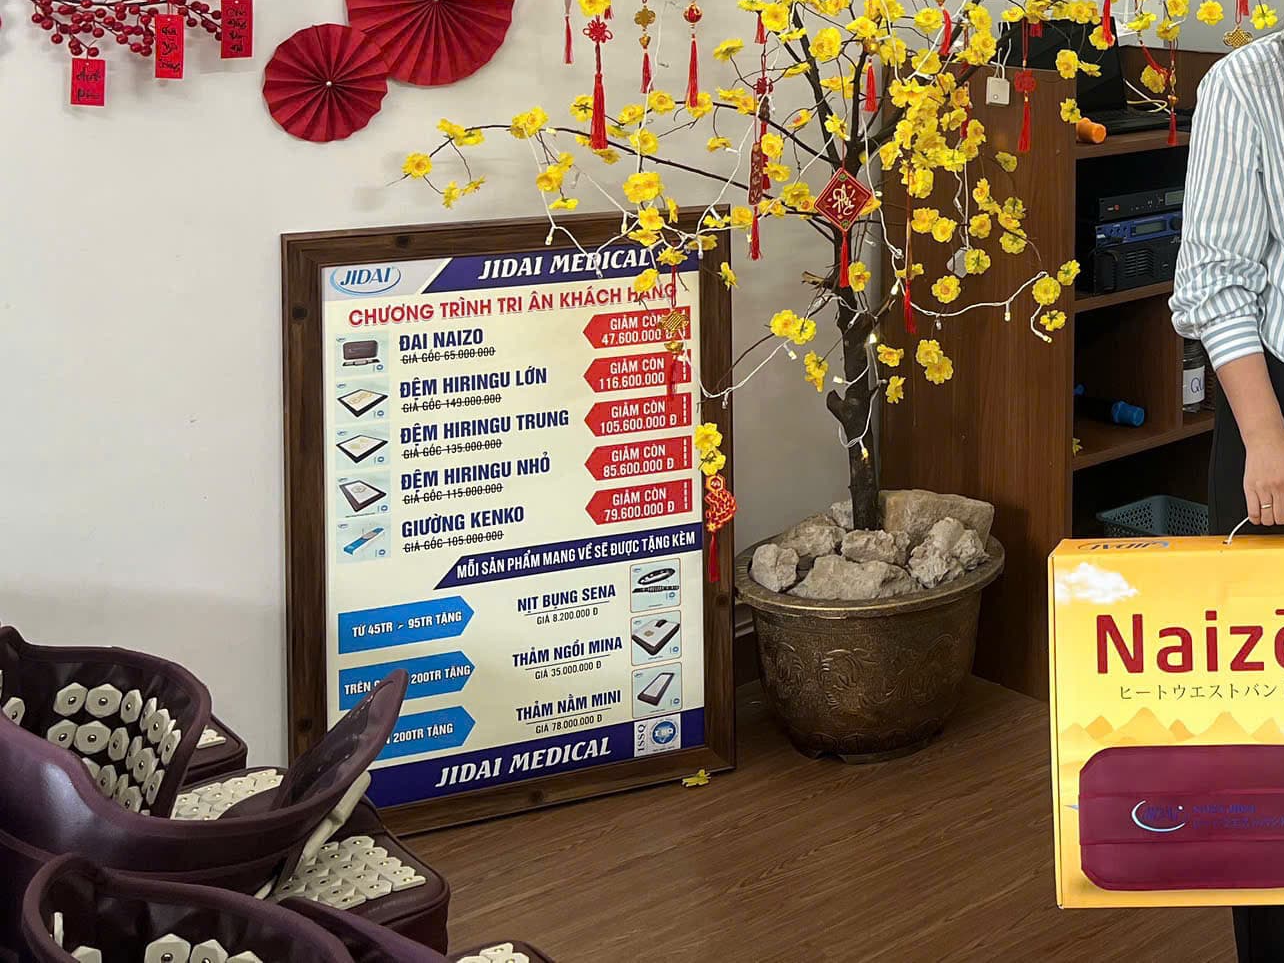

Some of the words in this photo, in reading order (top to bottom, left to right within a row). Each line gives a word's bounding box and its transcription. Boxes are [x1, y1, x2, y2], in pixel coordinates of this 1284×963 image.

[340, 267, 391, 286] JIDAI
[478, 255, 543, 280] JIDAI
[549, 248, 651, 273] MEDICAL
[348, 303, 434, 326] CHƯƠNG
[439, 297, 492, 318] TRÌNH
[497, 296, 522, 313] TRI
[528, 291, 553, 309] ÂN
[560, 286, 621, 307] KHÁCH
[399, 333, 427, 351] ĐAI
[433, 328, 483, 348] NAIZO
[601, 329, 662, 346] 47.600.000
[610, 358, 638, 374] GIẢM
[642, 357, 664, 371] CÒN
[399, 377, 437, 400] ĐỆM
[443, 371, 510, 394] HIRINGU
[515, 366, 547, 386] LỚN
[600, 372, 665, 390] 116.600.000
[611, 402, 639, 418] GIẢM
[643, 400, 665, 414] CÒN
[400, 423, 438, 446] ĐỆM
[443, 416, 511, 439] HIRINGU
[516, 410, 569, 431] TRUNG
[600, 415, 666, 434] 105.600.000
[611, 445, 639, 462] GIẢM
[643, 444, 666, 458] CÒN
[400, 469, 438, 493] ĐỆM
[444, 461, 512, 485] HIRINGU
[516, 451, 550, 476] NHỎ
[603, 458, 663, 477] 85.600.000
[612, 489, 640, 506] GIẢM
[644, 487, 666, 501] CÒN
[401, 513, 465, 538] GIƯỜNG
[470, 506, 525, 529] KENKO
[604, 502, 664, 522] 79.600.000
[481, 557, 505, 576] SẢN
[507, 549, 541, 572] PHẨM
[542, 549, 576, 567] MANG
[577, 543, 593, 560] VỀ
[594, 541, 608, 558] SẼ
[609, 539, 640, 558] ĐƯỢC
[641, 535, 670, 553] TẶNG
[672, 530, 696, 547] KÈM
[517, 596, 539, 615] NỊT
[542, 589, 578, 609] BỤNG
[581, 584, 616, 601] SENA
[512, 646, 550, 667] THẢM
[588, 637, 623, 654] MINA
[516, 700, 553, 721] THẢM
[591, 689, 622, 707] MINI
[434, 756, 502, 788] JIDAI
[508, 736, 612, 774] MEDICAL
